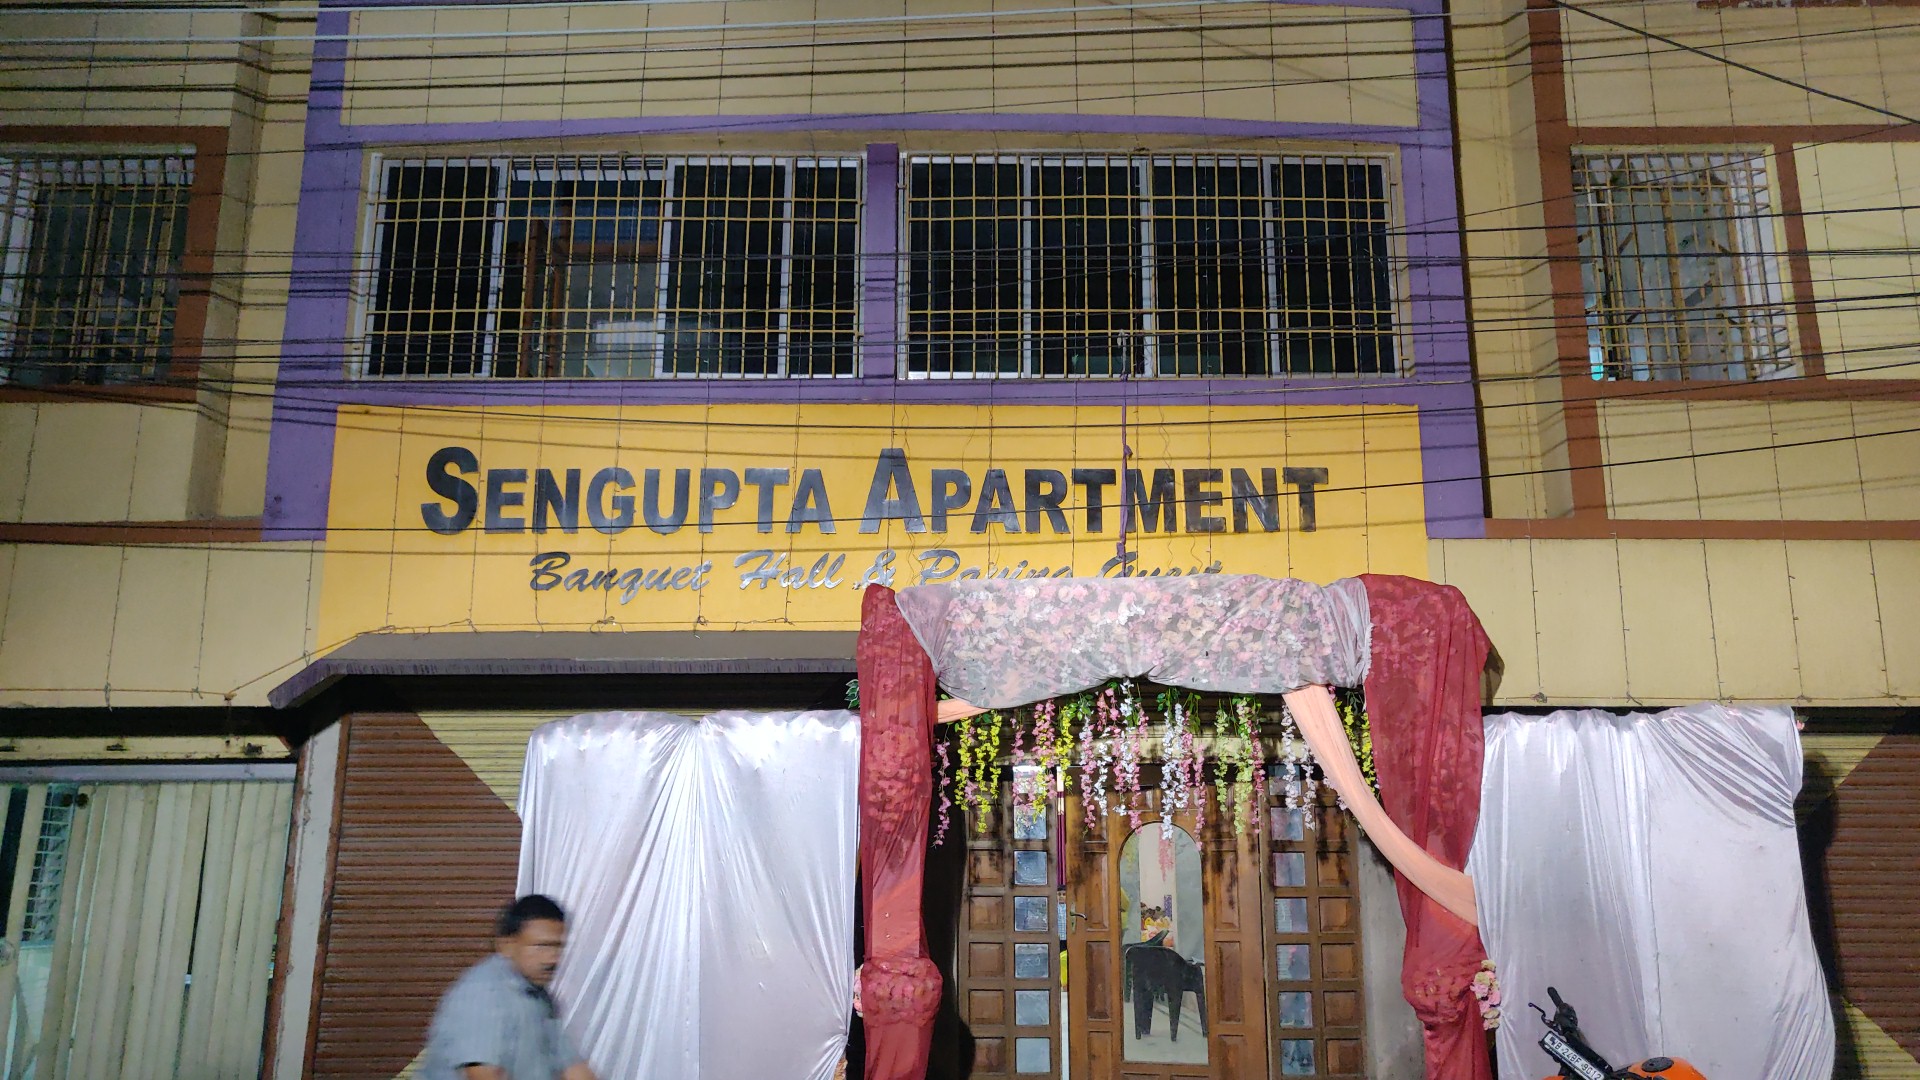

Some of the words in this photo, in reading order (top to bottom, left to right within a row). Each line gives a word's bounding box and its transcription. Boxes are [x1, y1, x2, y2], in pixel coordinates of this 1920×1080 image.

[420, 446, 836, 535] SENGUPTA
[858, 447, 1329, 534] APARTMENT
[529, 551, 713, 606] Banquet
[733, 549, 847, 590] Hall
[852, 549, 896, 590] &
